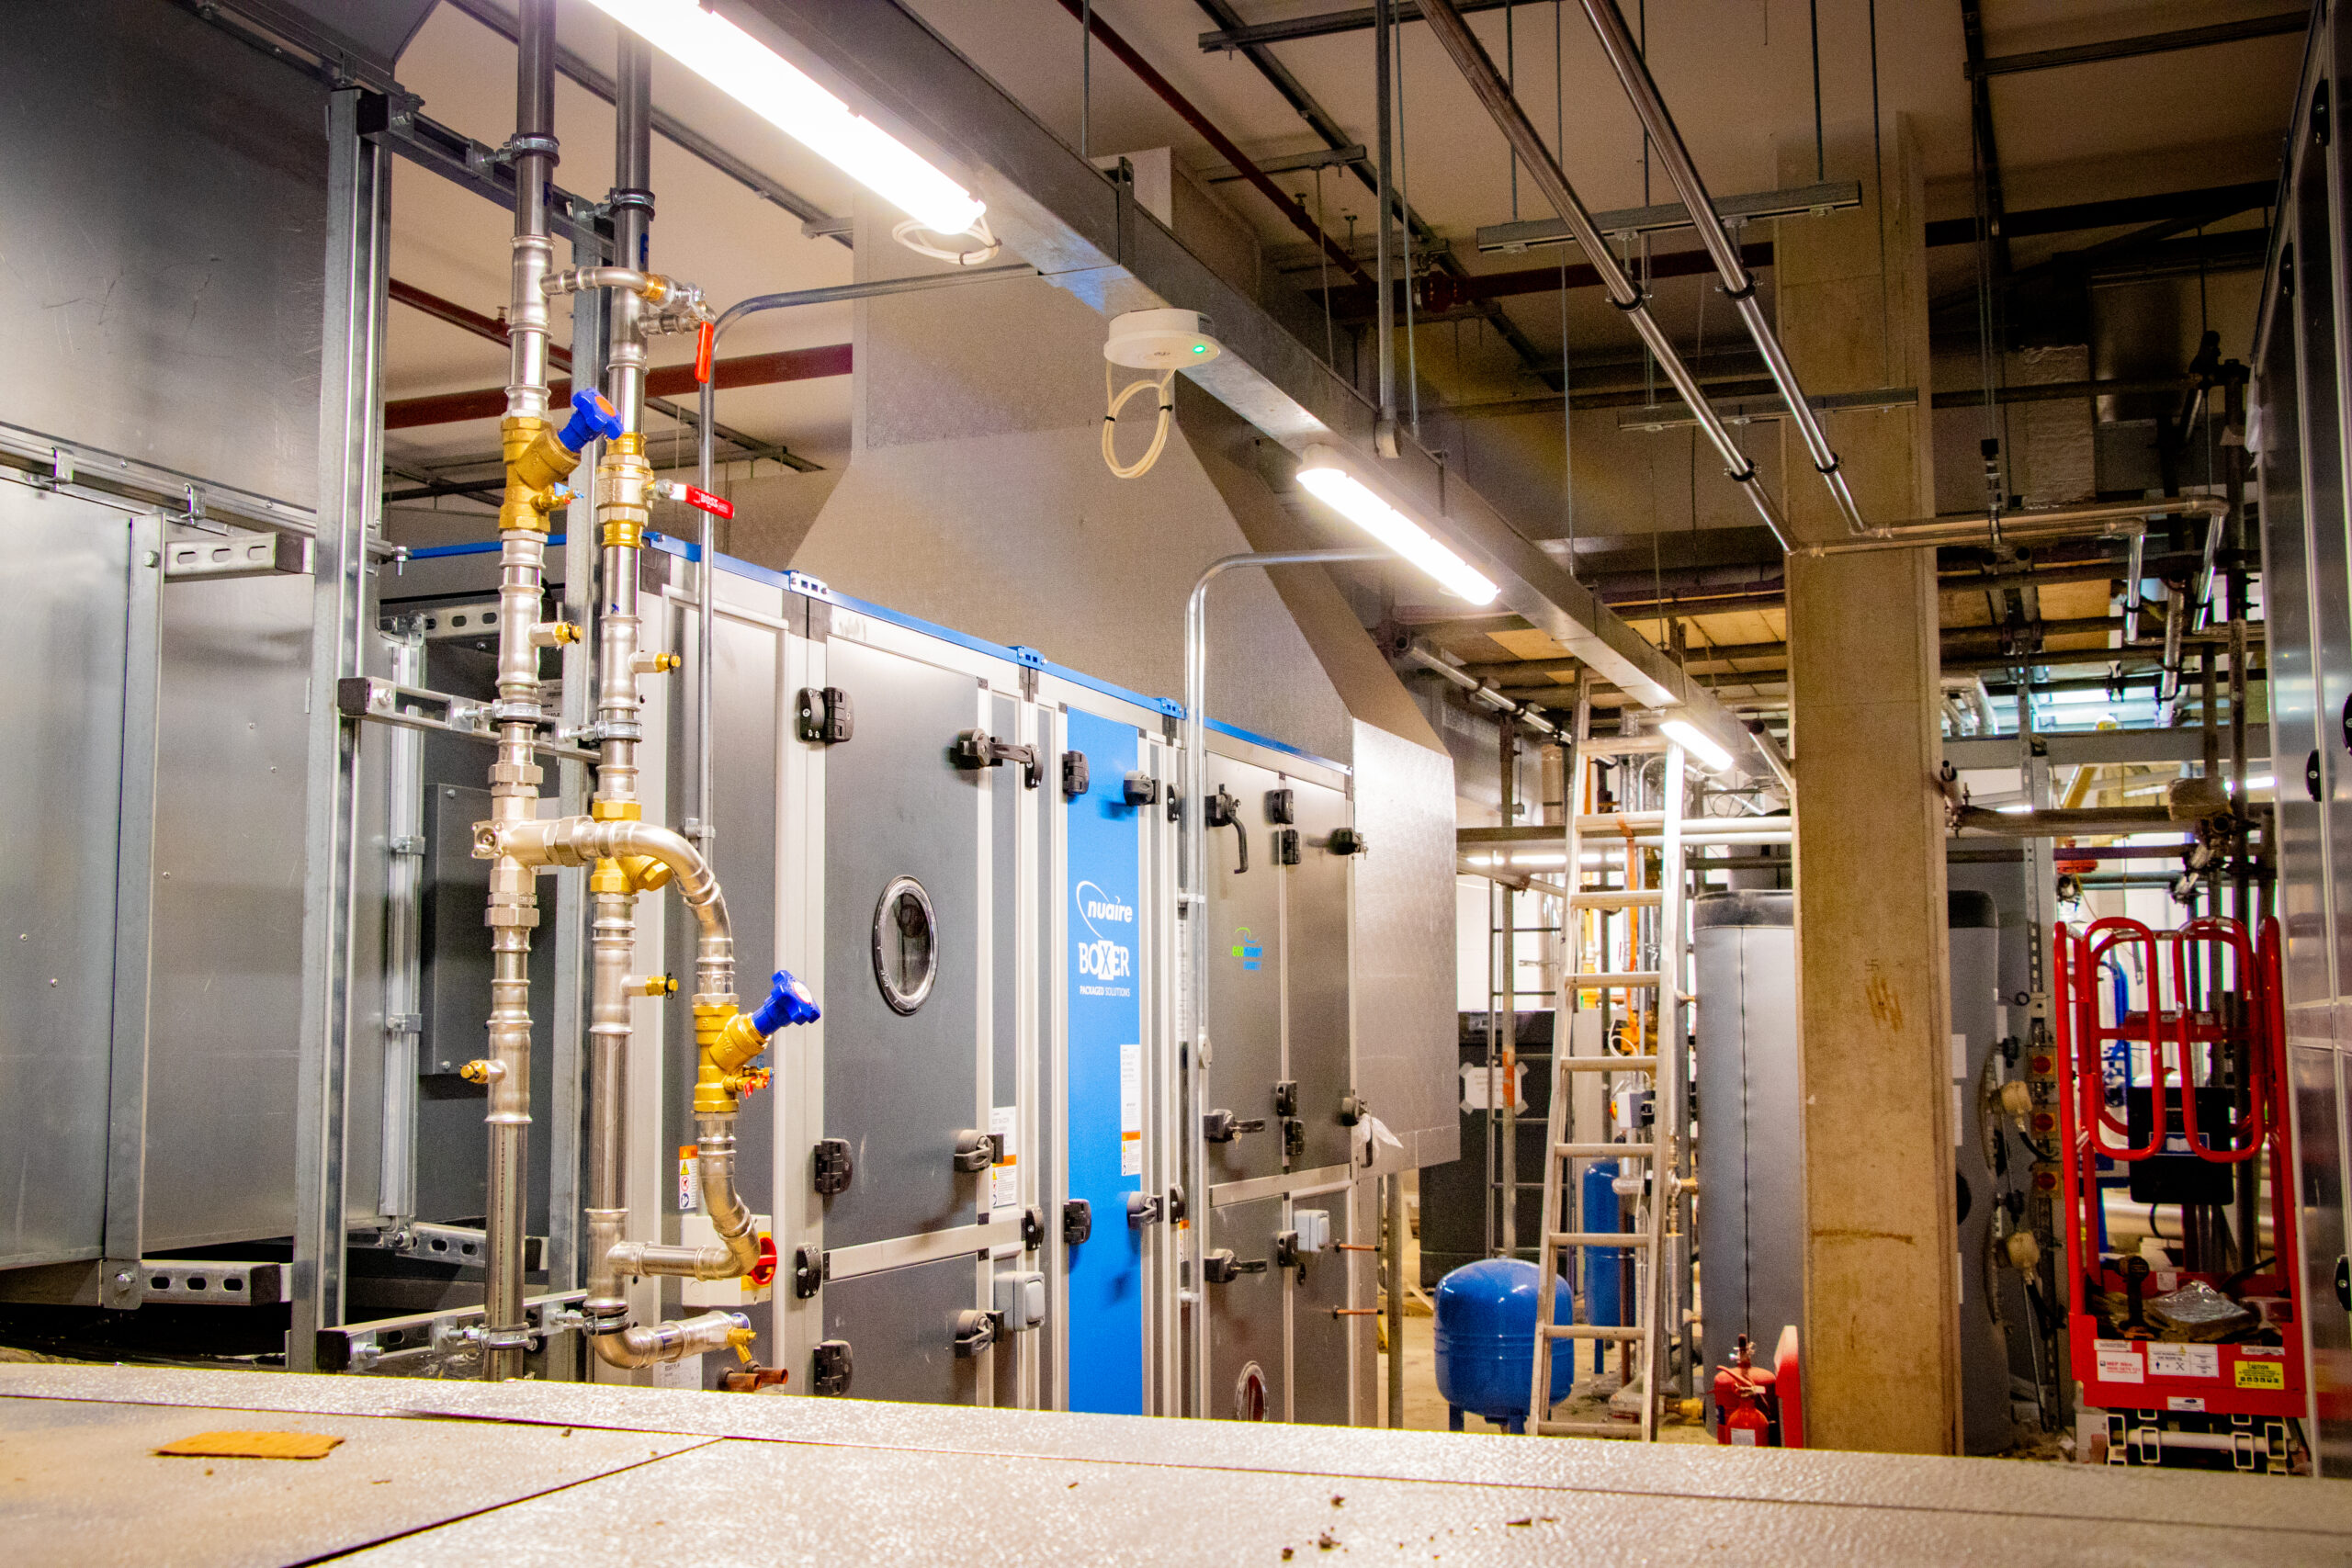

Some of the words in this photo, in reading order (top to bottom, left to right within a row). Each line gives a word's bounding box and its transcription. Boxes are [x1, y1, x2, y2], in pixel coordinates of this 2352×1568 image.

[1088, 897, 1133, 923] nuaire
[1078, 940, 1131, 980] BOXER
[1080, 985, 1104, 996] PACKAGED
[1104, 987, 1130, 997] SOLUTIONS
